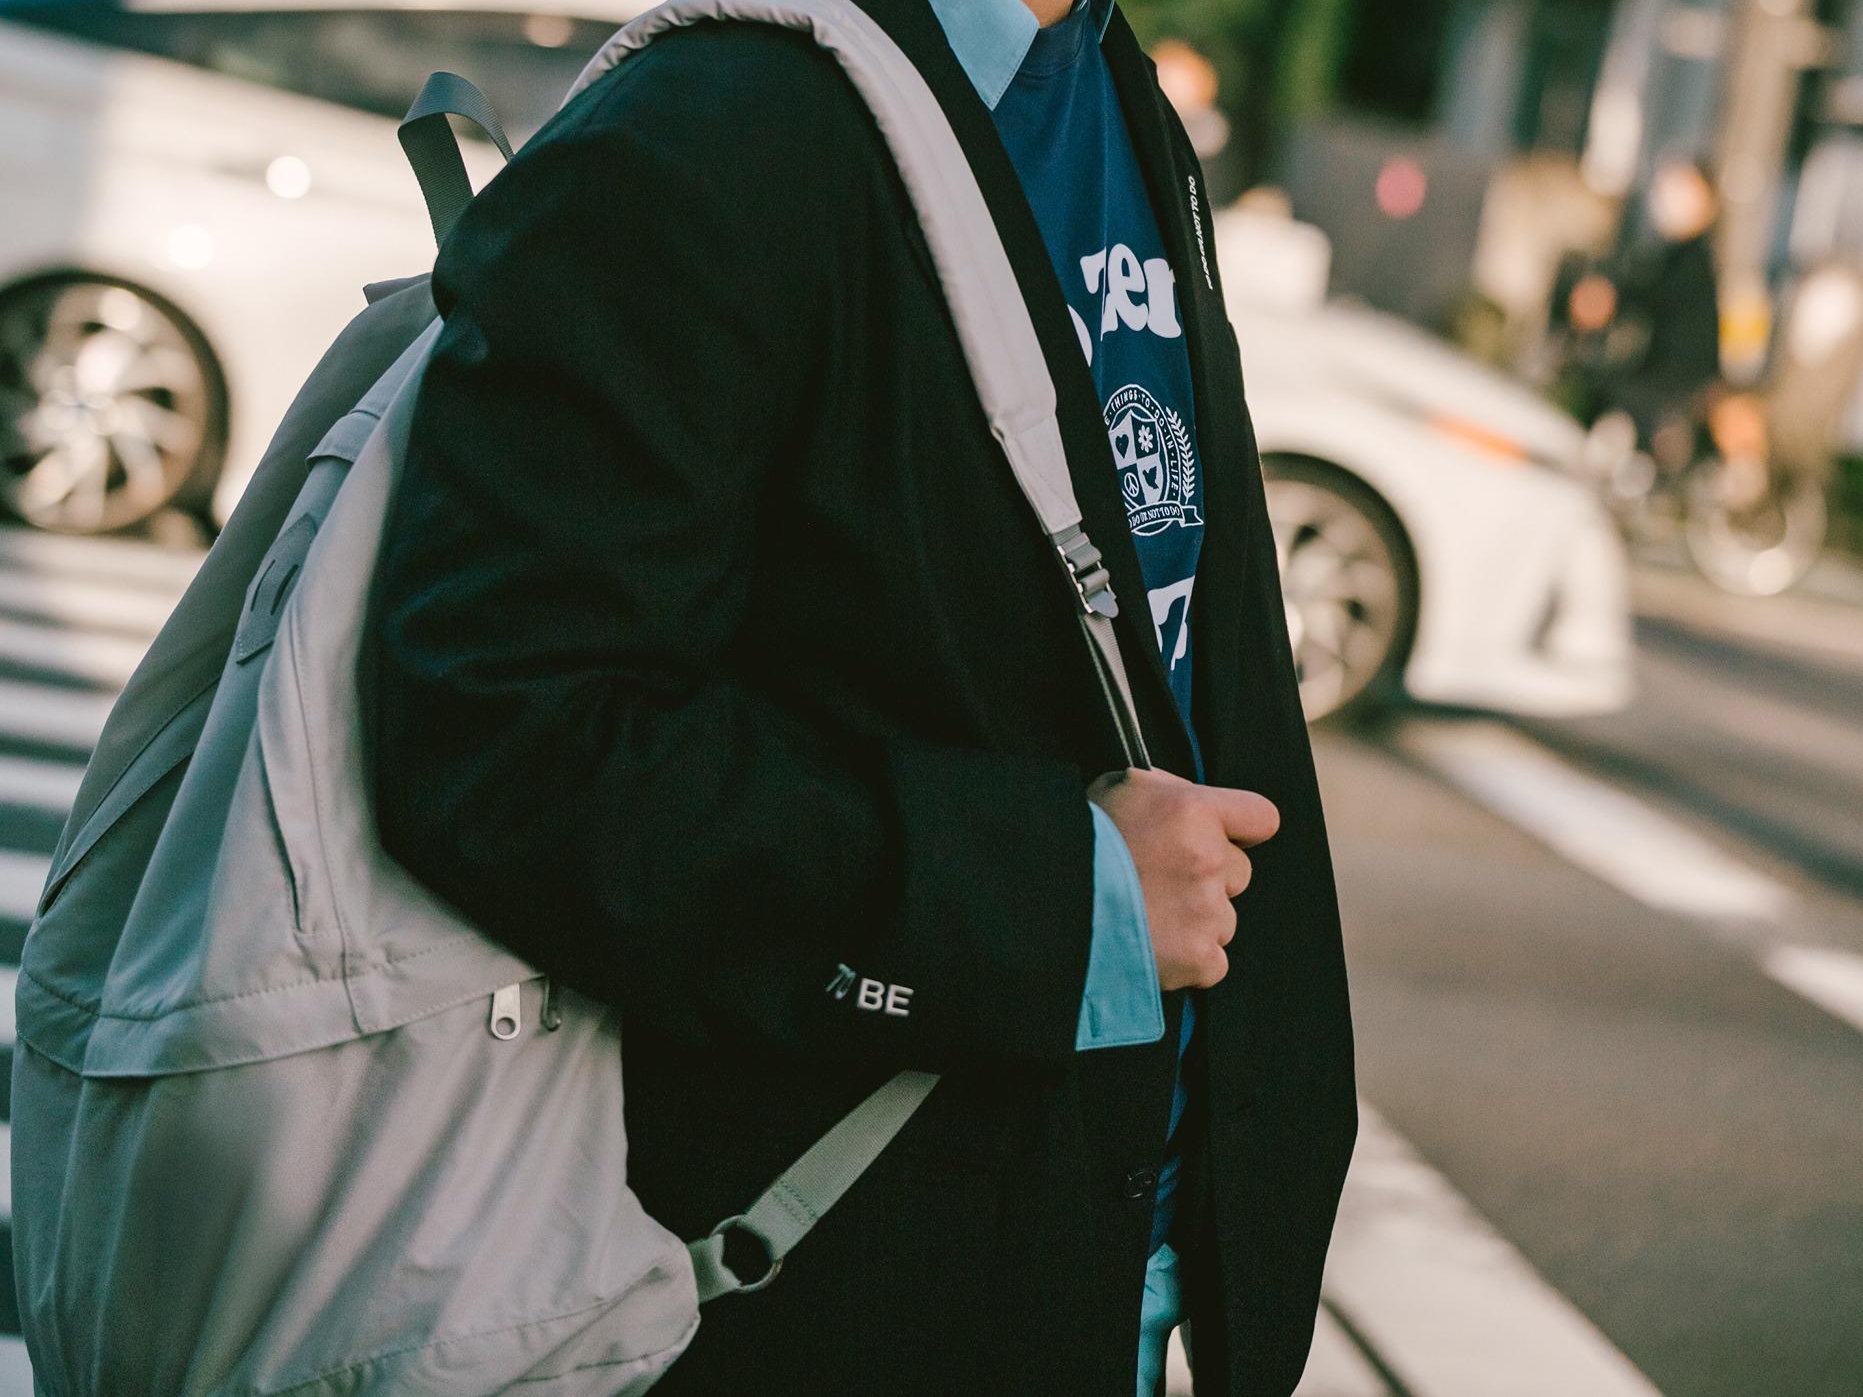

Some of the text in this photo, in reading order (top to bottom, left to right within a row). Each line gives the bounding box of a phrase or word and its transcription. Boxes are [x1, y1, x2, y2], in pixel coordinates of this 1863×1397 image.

[1188, 175, 1197, 195] DO
[1190, 195, 1199, 212] TO
[1192, 211, 1203, 239] NOT
[1111, 389, 1138, 412] THINGS
[1141, 393, 1150, 408] TO
[1154, 409, 1165, 427] DO
[1165, 434, 1175, 449] IN
[1170, 460, 1179, 491] LIFE
[1147, 507, 1160, 520] NOT
[1160, 506, 1170, 517] TO
[1169, 505, 1180, 517] DO
[857, 977, 914, 1017] BE
